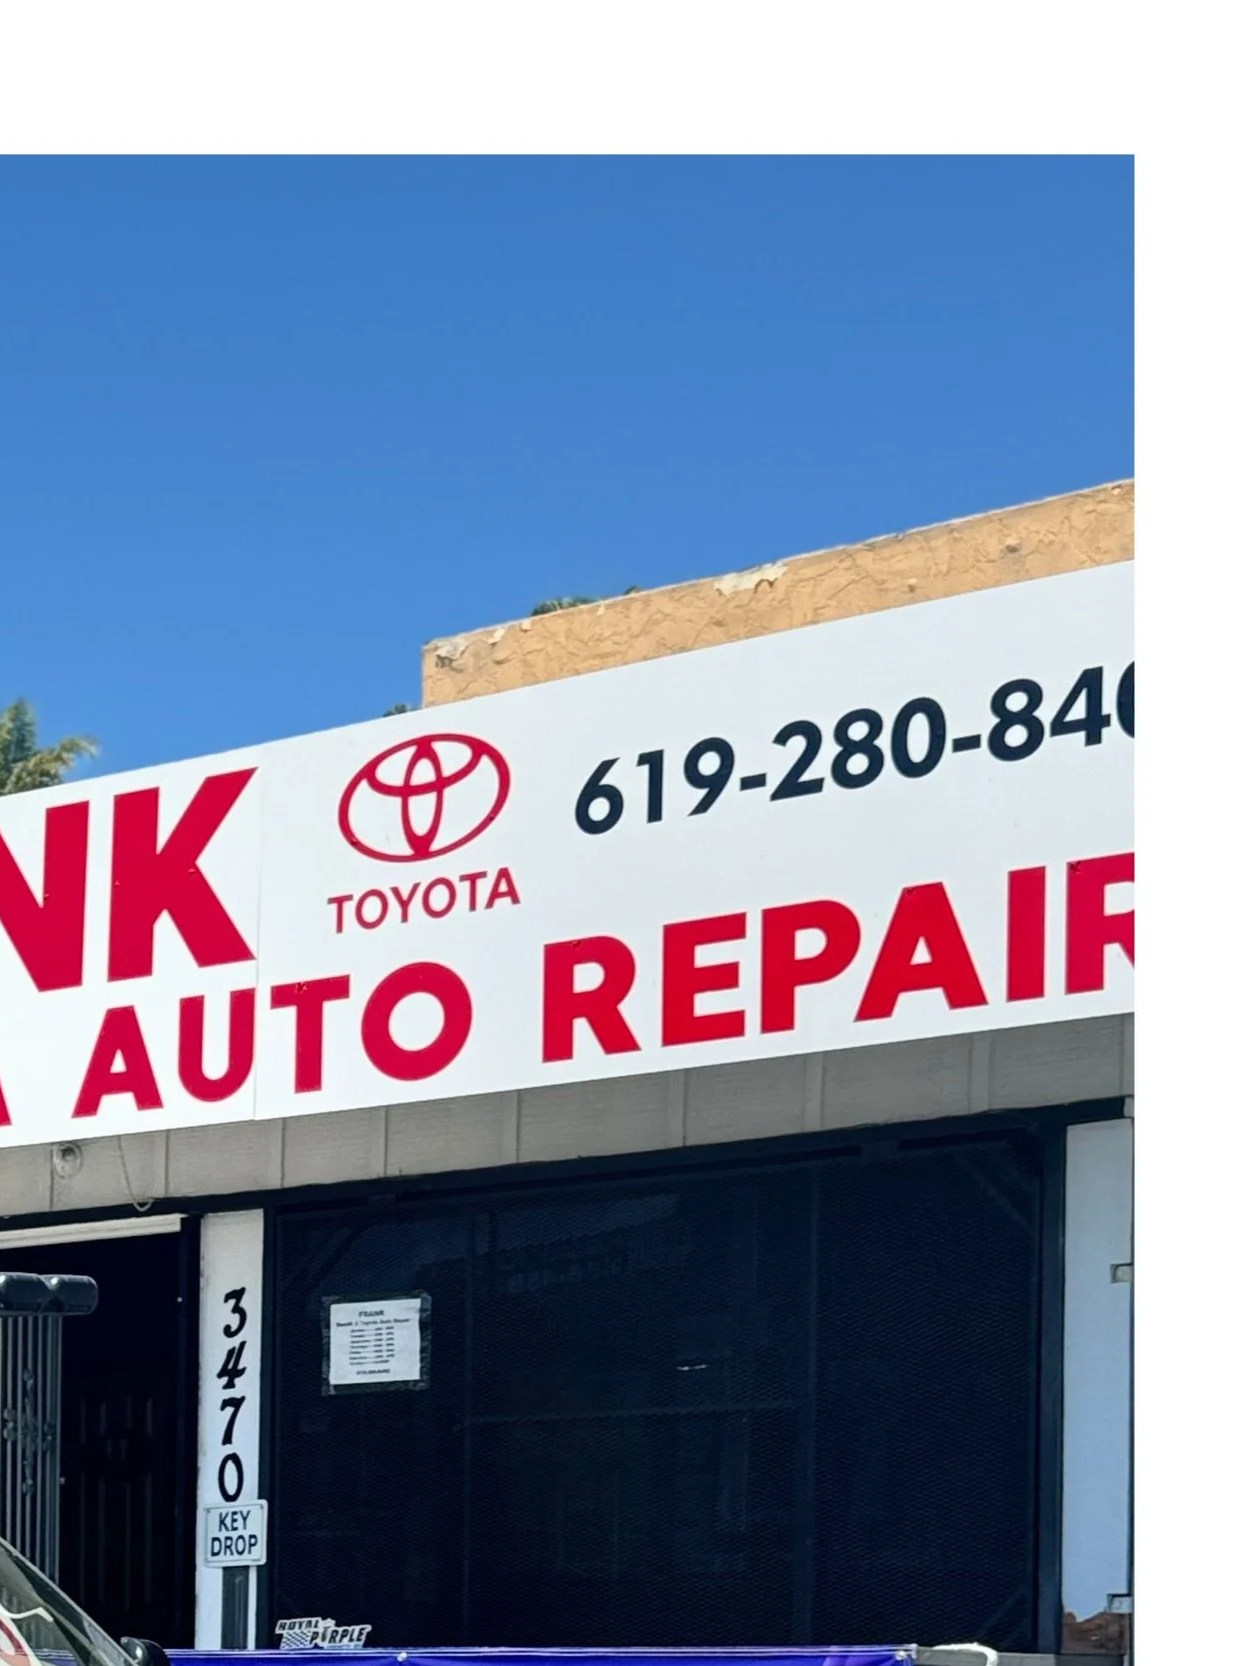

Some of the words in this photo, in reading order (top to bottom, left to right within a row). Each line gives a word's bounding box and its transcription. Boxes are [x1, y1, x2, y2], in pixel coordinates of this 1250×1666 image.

[326, 867, 521, 933] TOYOTA
[72, 960, 475, 1118] AUTO
[216, 1287, 248, 1502] 3470
[218, 1510, 252, 1531] KEY
[210, 1534, 258, 1557] DROP
[277, 1619, 321, 1632] ROYAL
[309, 1626, 368, 1645] PURPLE
